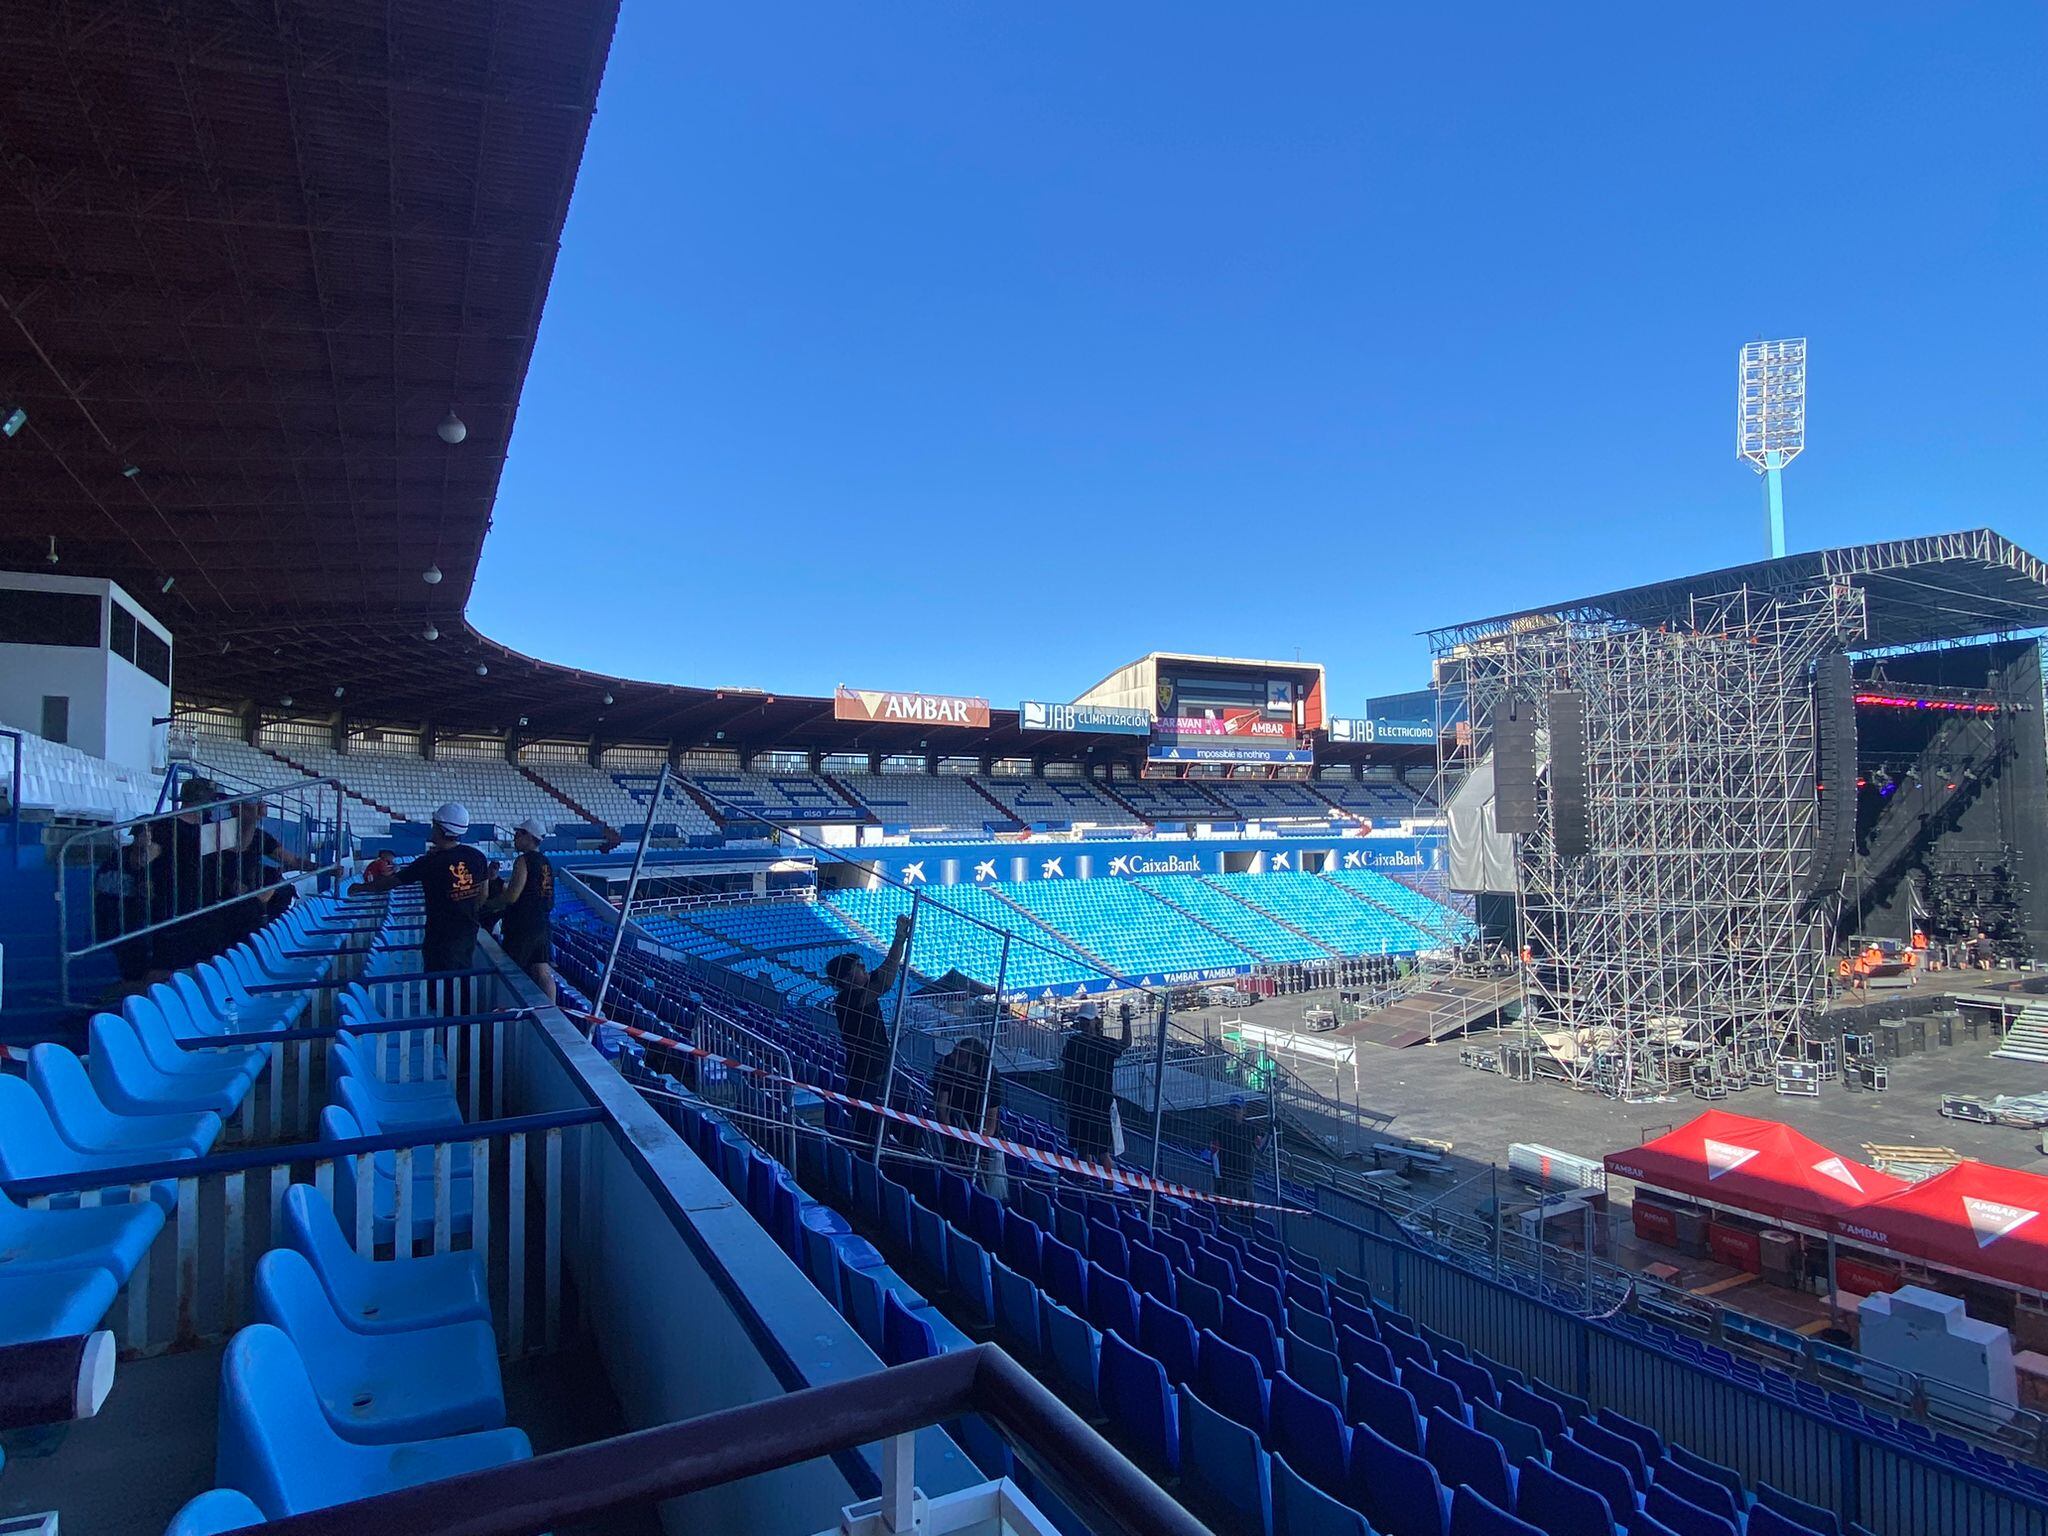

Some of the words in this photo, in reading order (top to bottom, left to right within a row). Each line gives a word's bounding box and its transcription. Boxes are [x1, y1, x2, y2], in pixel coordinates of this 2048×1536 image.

[885, 696, 971, 722] AMBAR
[1047, 704, 1075, 730] JAB
[1078, 712, 1148, 727] CLIMATIZACIÓN
[1250, 722, 1284, 734] AMBAR
[1352, 720, 1375, 742] JAB
[1378, 727, 1433, 738] ELECTRICIDAD
[1244, 751, 1271, 761] nothing
[1130, 854, 1201, 873] CaixaBank
[1361, 850, 1424, 866] CaixaBank
[1170, 971, 1199, 983] AMBAR
[1207, 967, 1236, 980] AMBAR
[1614, 1163, 1645, 1179] AMBAR
[1971, 1201, 2018, 1218] AMBAR
[1846, 1224, 1889, 1244] AMBAR
